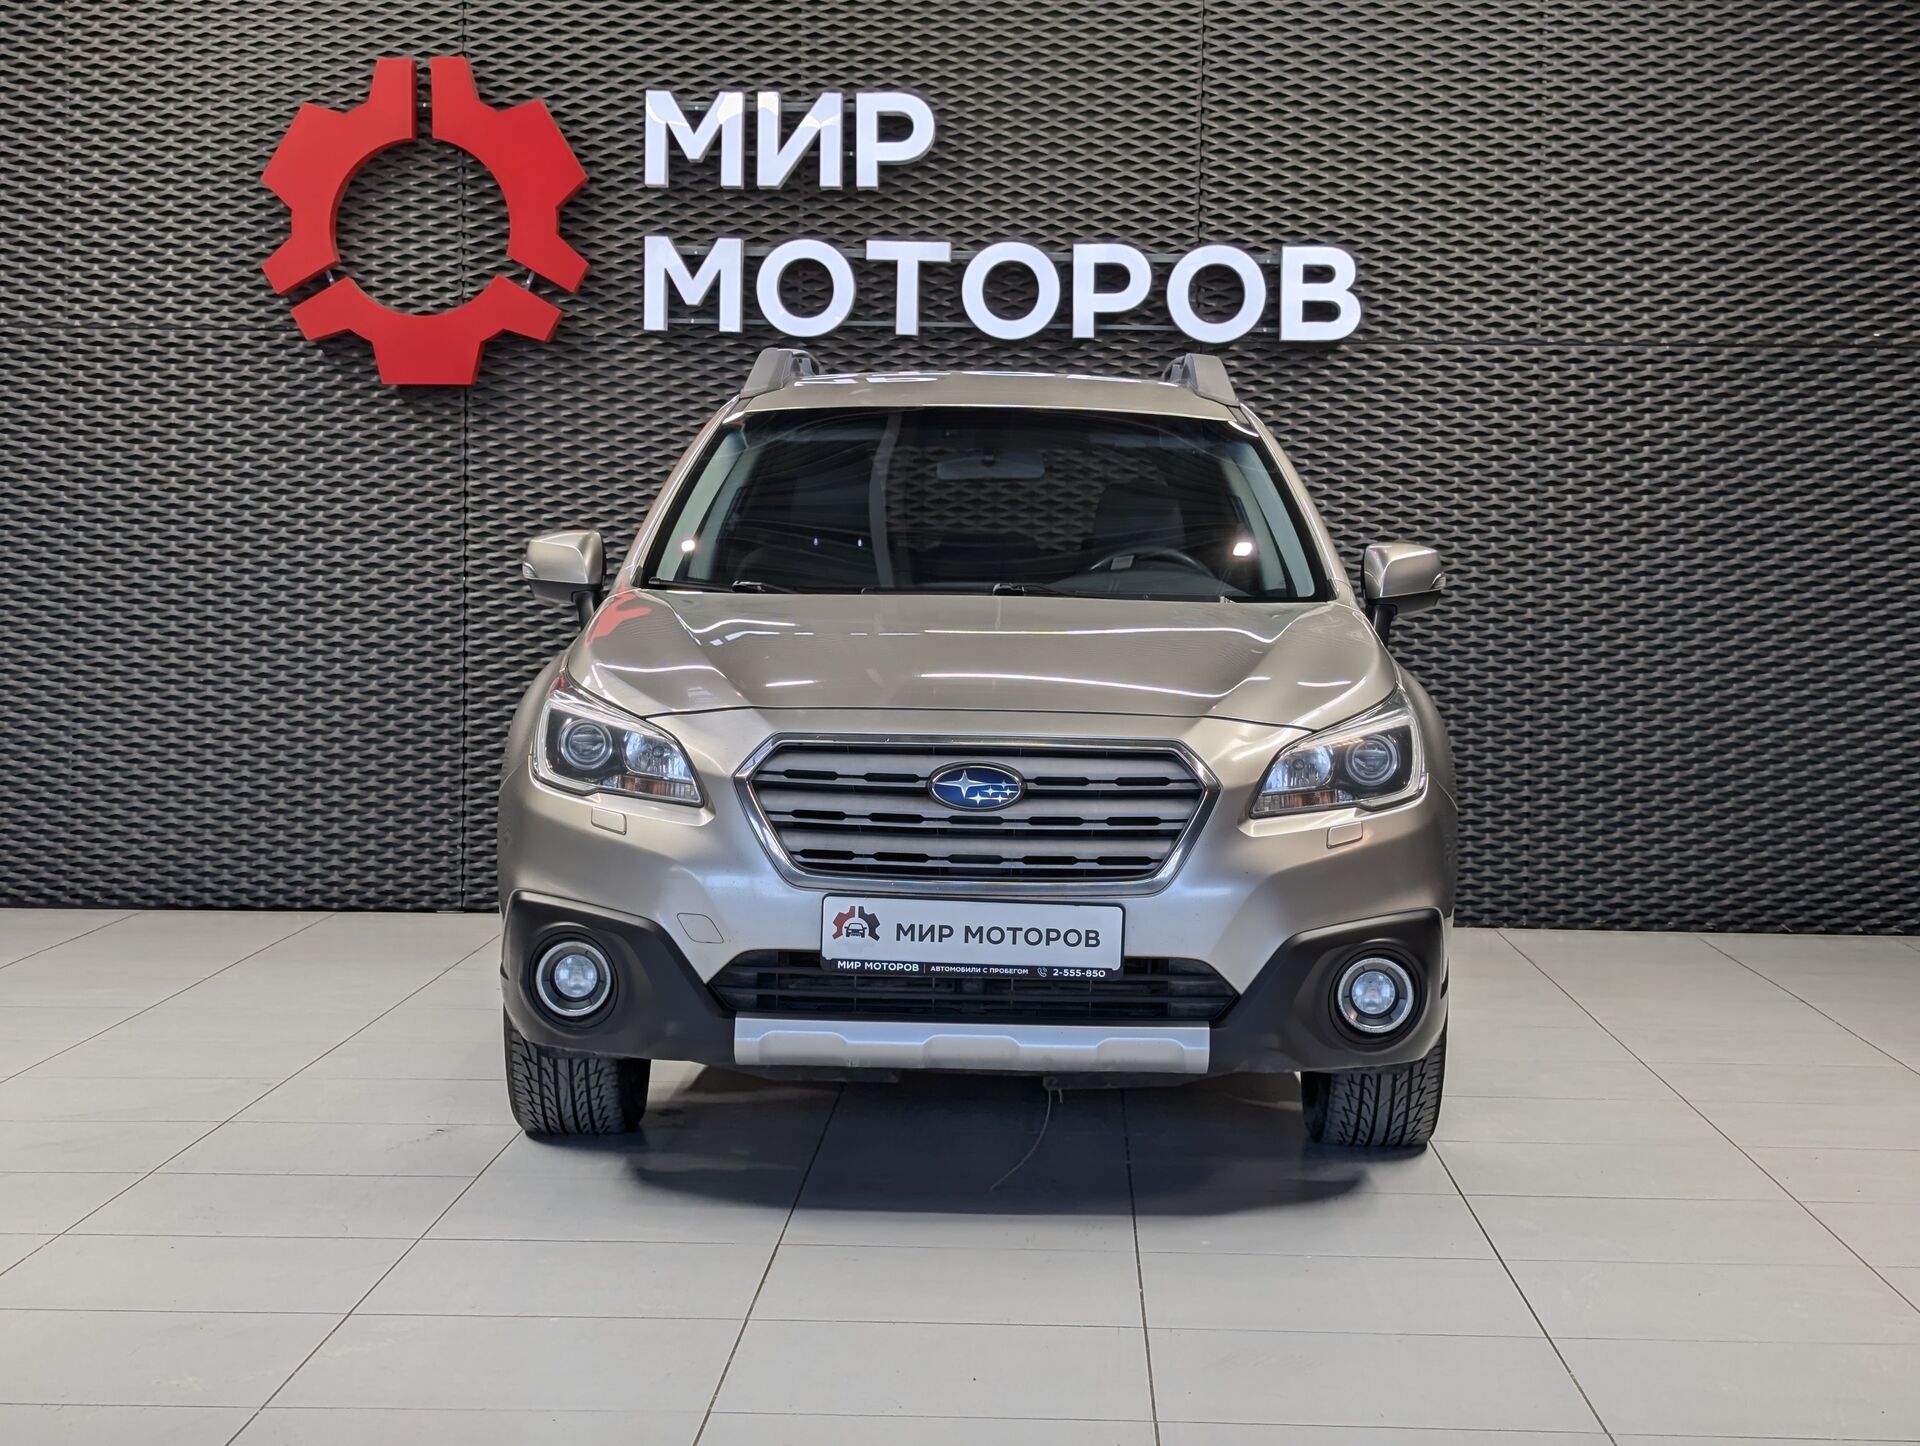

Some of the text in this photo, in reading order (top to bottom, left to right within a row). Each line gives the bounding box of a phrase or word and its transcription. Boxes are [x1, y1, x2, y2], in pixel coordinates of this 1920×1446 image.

[643, 90, 936, 190] МИР
[643, 234, 1363, 343] МОТОРОВ
[895, 922, 1101, 948] МИР МОТОРОВ
[837, 960, 862, 970] МИР
[864, 961, 920, 972] МОТОРОВ
[930, 965, 982, 974] АВТОМОБИЛИ
[989, 967, 1029, 975] ПРОБЕГОМ
[1052, 968, 1106, 978] 2-555-850
